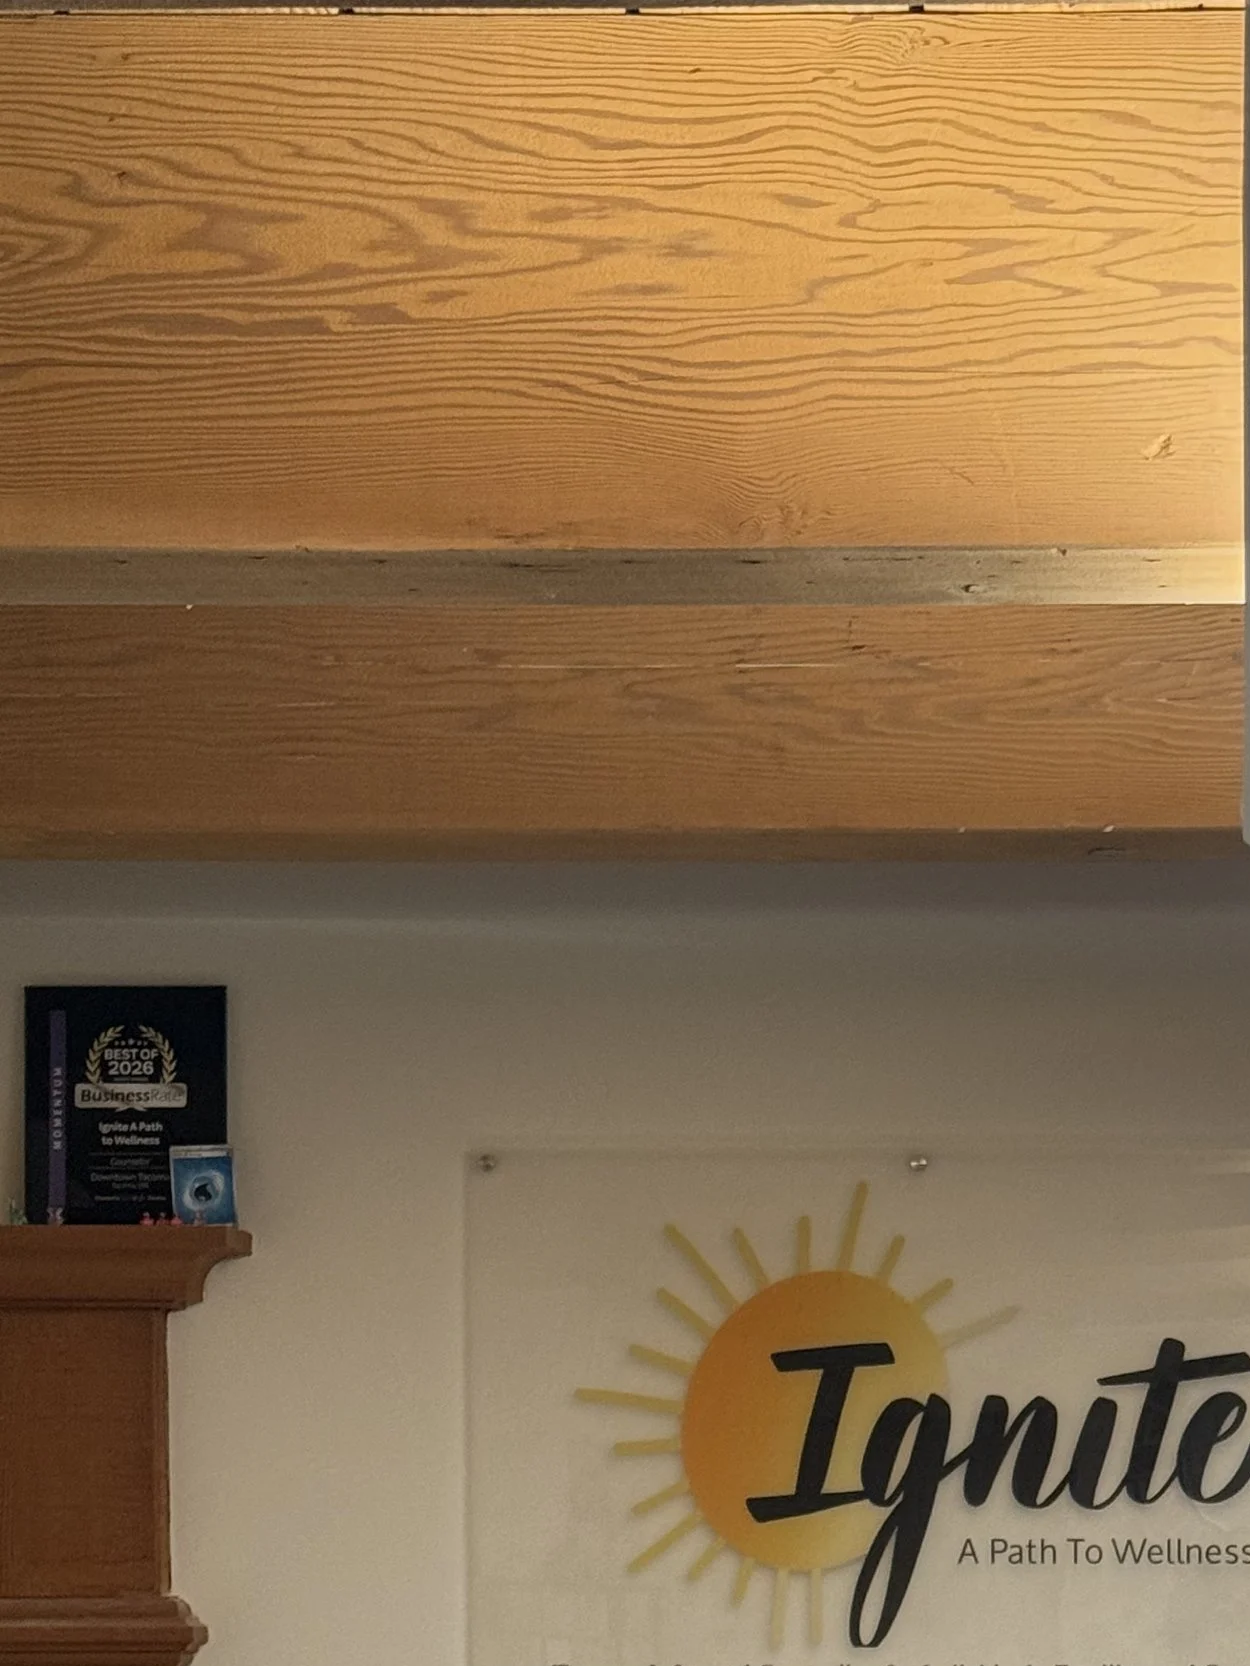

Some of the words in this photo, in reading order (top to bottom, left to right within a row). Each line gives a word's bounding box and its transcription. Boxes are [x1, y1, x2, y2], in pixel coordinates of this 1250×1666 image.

[104, 1048, 139, 1060] BEST
[140, 1048, 159, 1060] OF
[108, 1061, 154, 1075] 2026
[98, 1121, 128, 1134] Ignite
[129, 1122, 137, 1131] A
[139, 1121, 163, 1132] Path
[101, 1136, 113, 1145] to
[114, 1135, 160, 1146] Wellness
[957, 1538, 979, 1565] A
[990, 1538, 1057, 1565] Path
[1066, 1538, 1103, 1565] To
